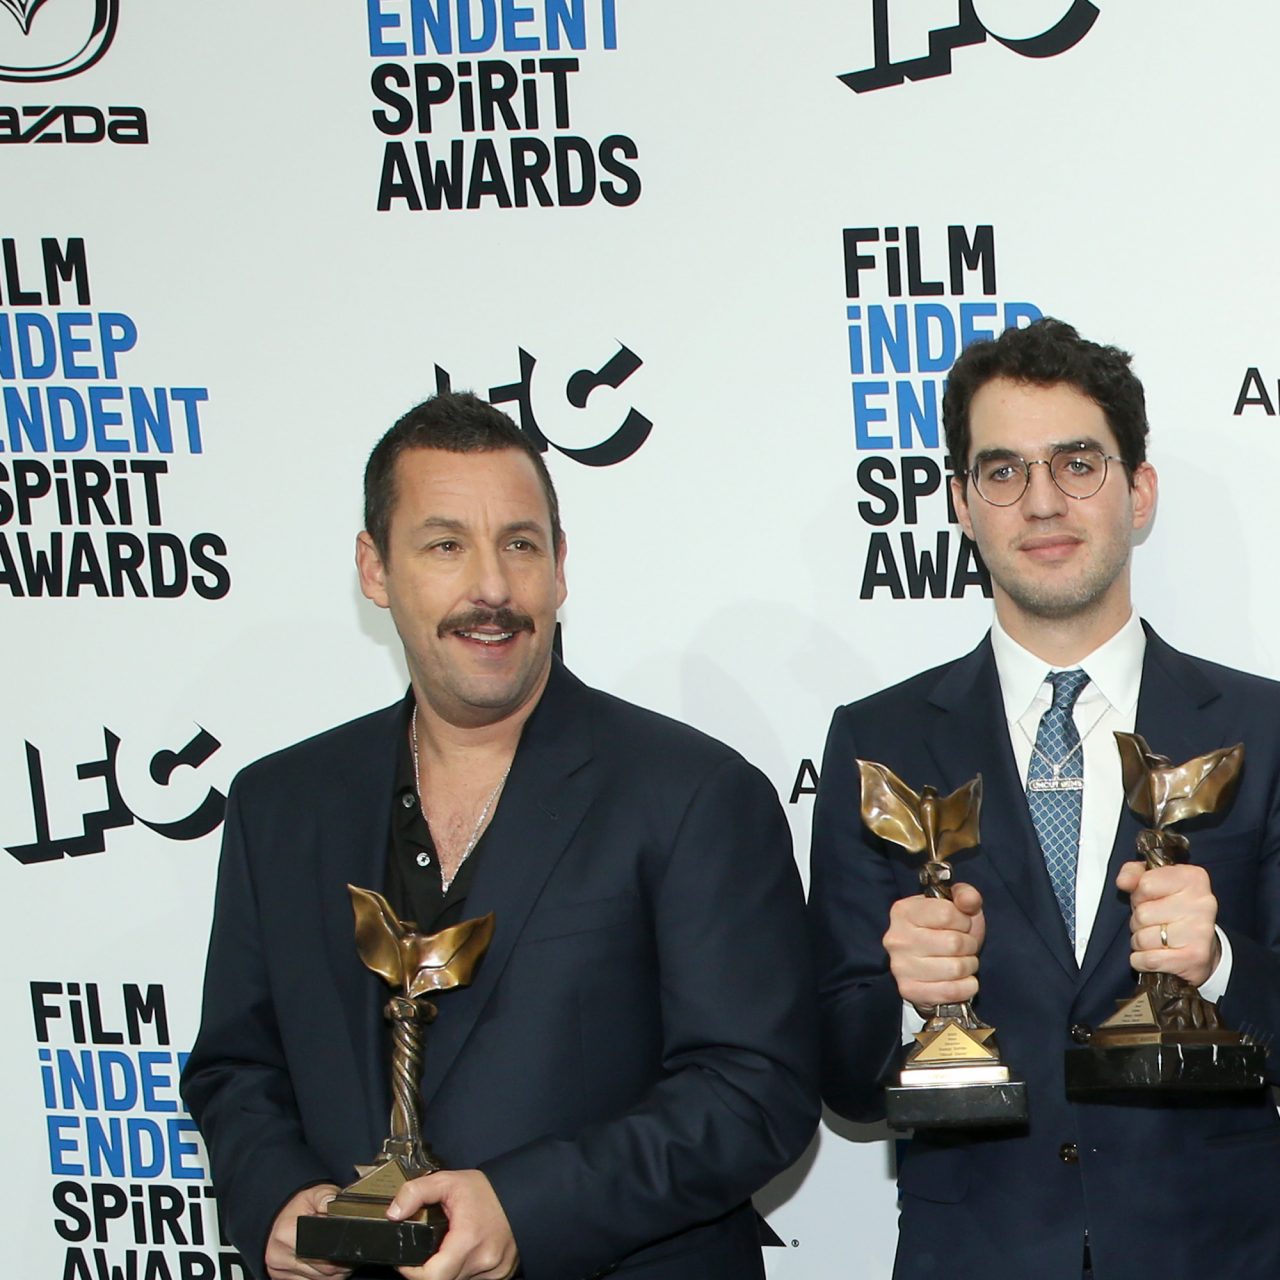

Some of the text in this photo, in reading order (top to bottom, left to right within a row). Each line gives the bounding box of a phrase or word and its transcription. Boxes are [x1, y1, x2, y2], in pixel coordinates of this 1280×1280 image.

[370, 57, 580, 136] SPiRiT
[376, 134, 642, 211] AWARDS
[0, 237, 92, 306] LM
[842, 224, 997, 298] FiLM
[0, 312, 138, 380] DEP
[0, 386, 209, 454] NDENT
[859, 530, 996, 600] AWA
[30, 981, 170, 1046] FiLM
[47, 1115, 206, 1180] ENDE
